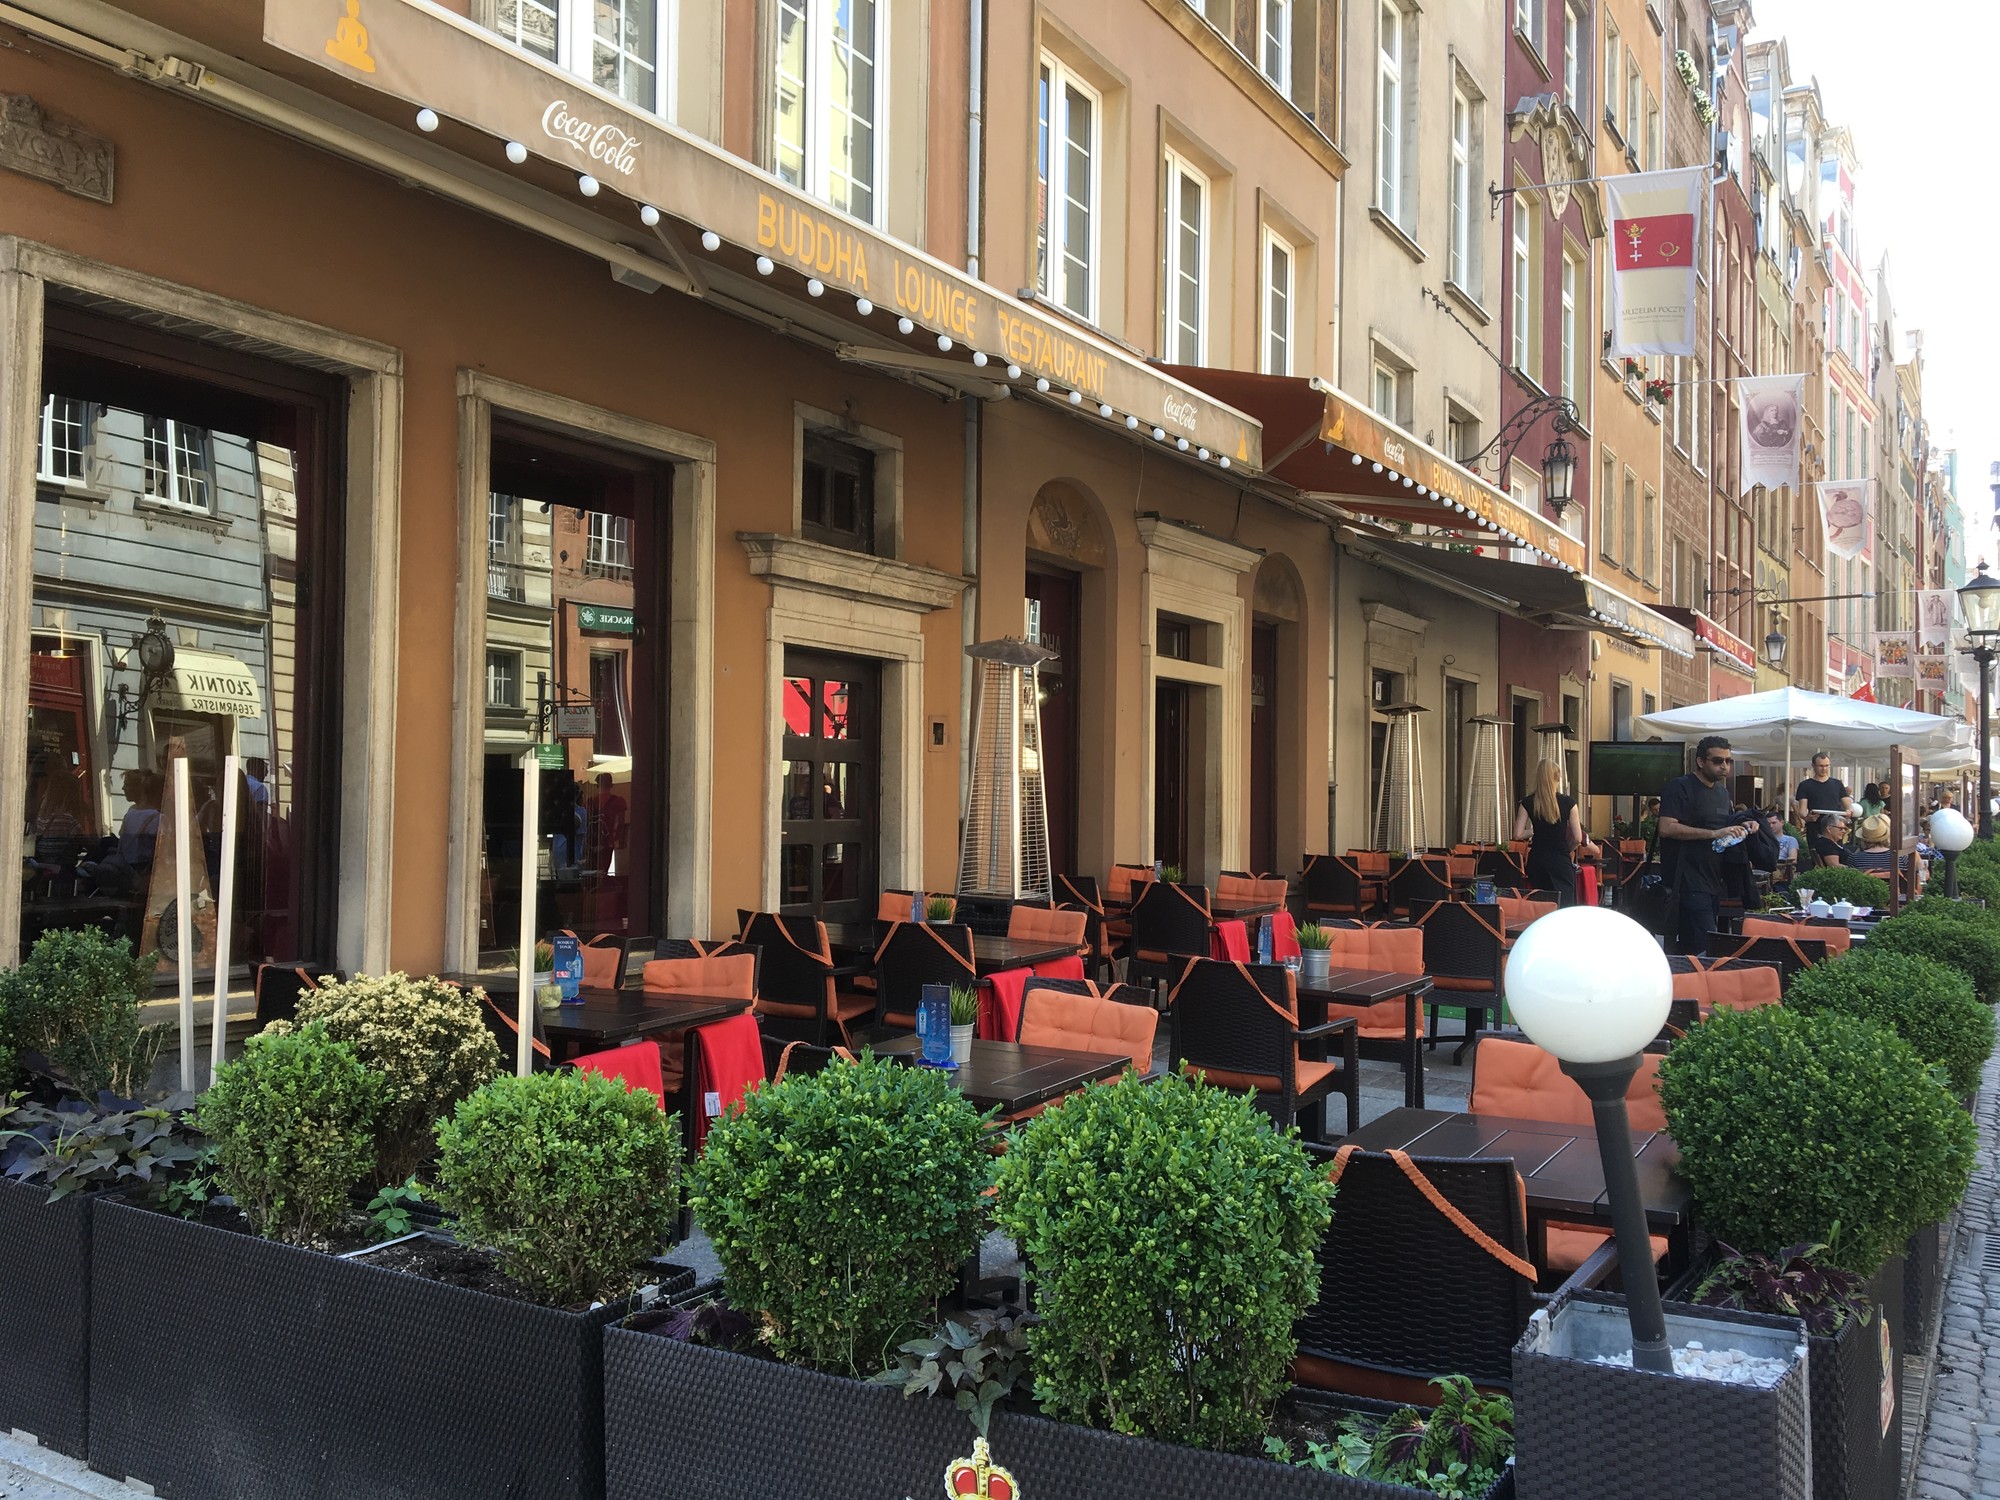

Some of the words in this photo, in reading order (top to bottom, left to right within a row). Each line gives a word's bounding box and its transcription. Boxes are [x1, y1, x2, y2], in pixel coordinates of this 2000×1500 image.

[758, 194, 868, 292] BUDDHA
[894, 259, 977, 340] LOUNGE
[997, 309, 1107, 396] RESTAURANT
[1658, 305, 1686, 313] POCZTY
[1433, 462, 1465, 502] BUDDHA
[1467, 482, 1492, 519] LOGE
